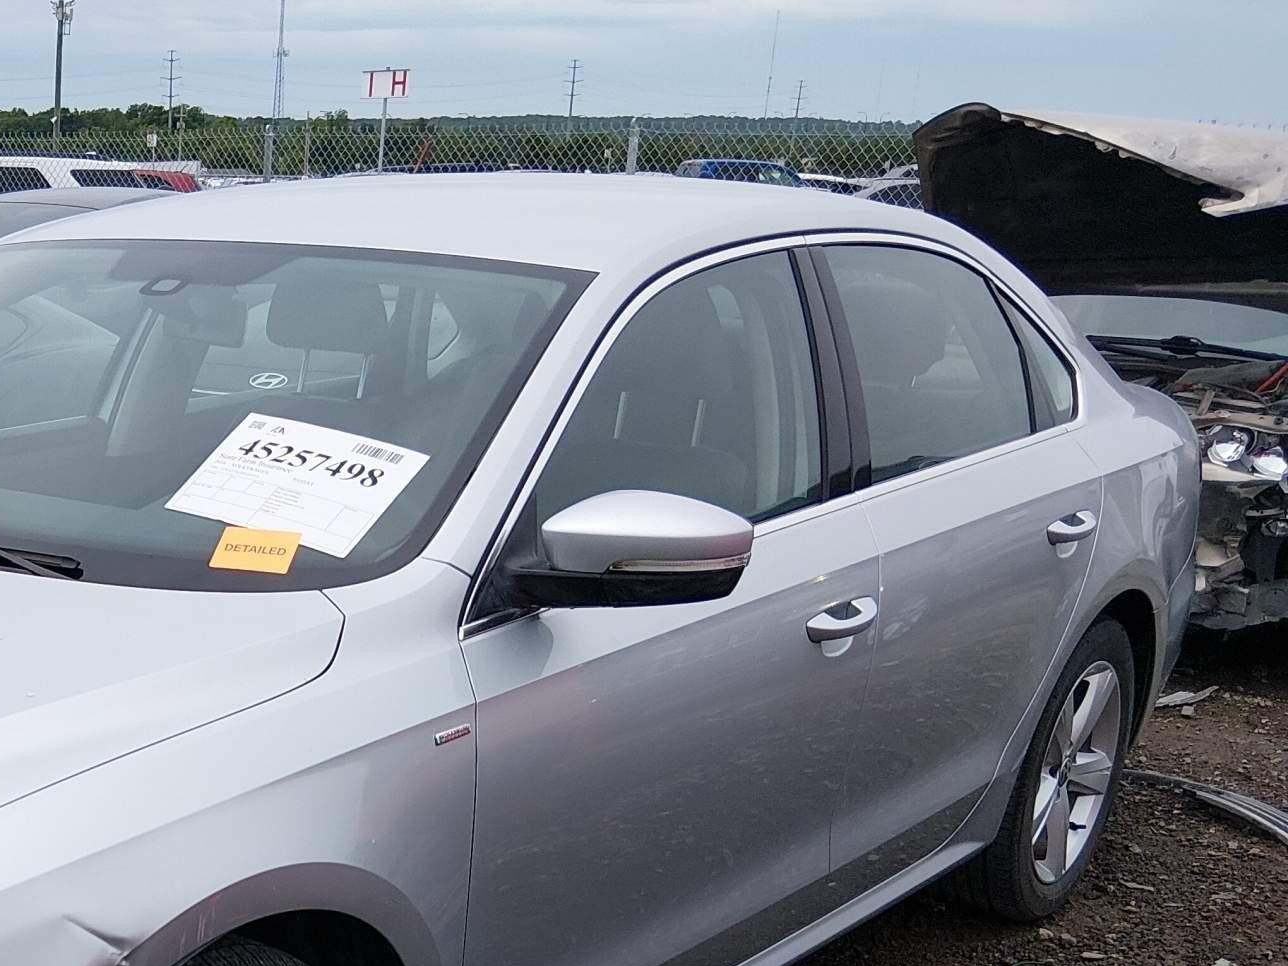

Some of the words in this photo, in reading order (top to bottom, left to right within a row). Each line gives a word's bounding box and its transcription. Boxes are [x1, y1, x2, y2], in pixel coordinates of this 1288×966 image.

[391, 70, 407, 97] H
[238, 439, 385, 488] 45257498
[224, 543, 287, 556] DETAILED
